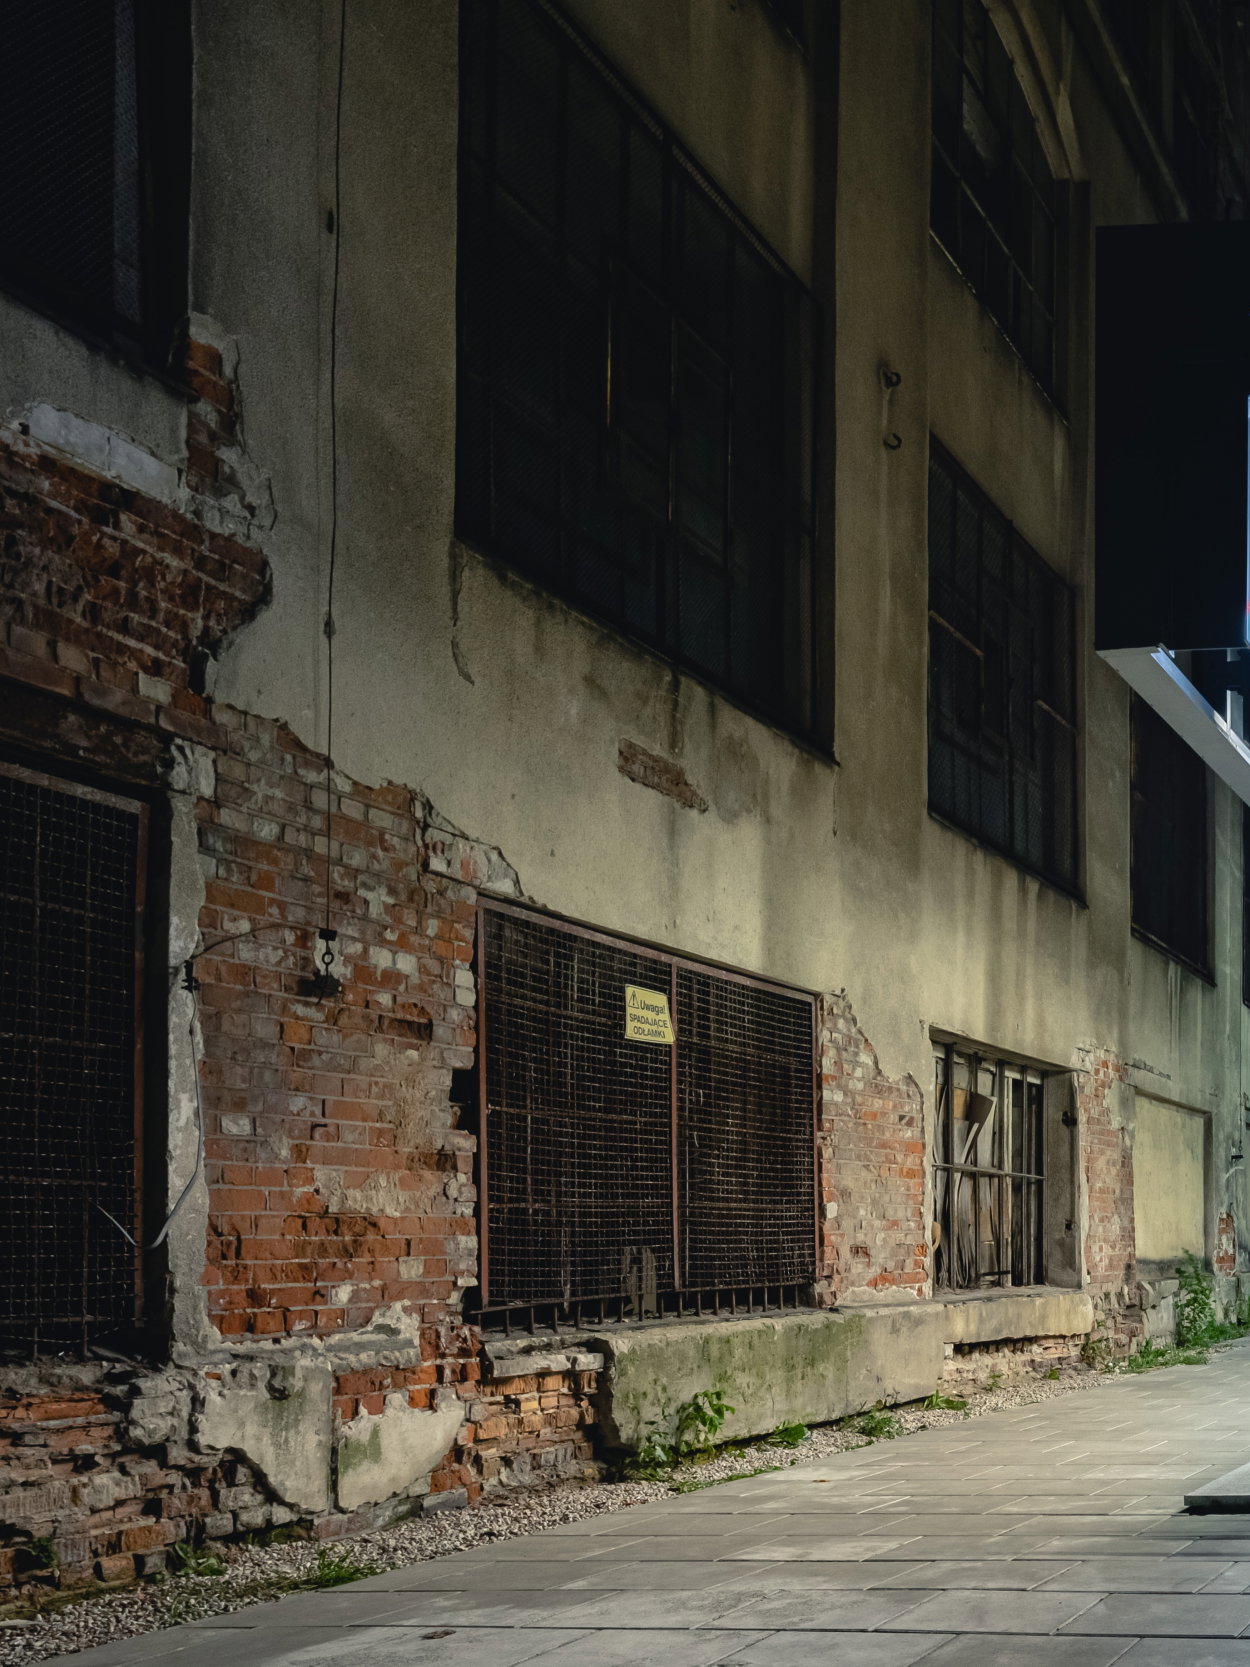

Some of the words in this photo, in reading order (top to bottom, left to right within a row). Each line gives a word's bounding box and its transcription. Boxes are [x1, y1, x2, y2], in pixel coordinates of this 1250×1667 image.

[640, 1000, 665, 1015] Uwaga!
[629, 1013, 669, 1028] SPADAJĄCE
[633, 1025, 665, 1038] ODŁAMKI
